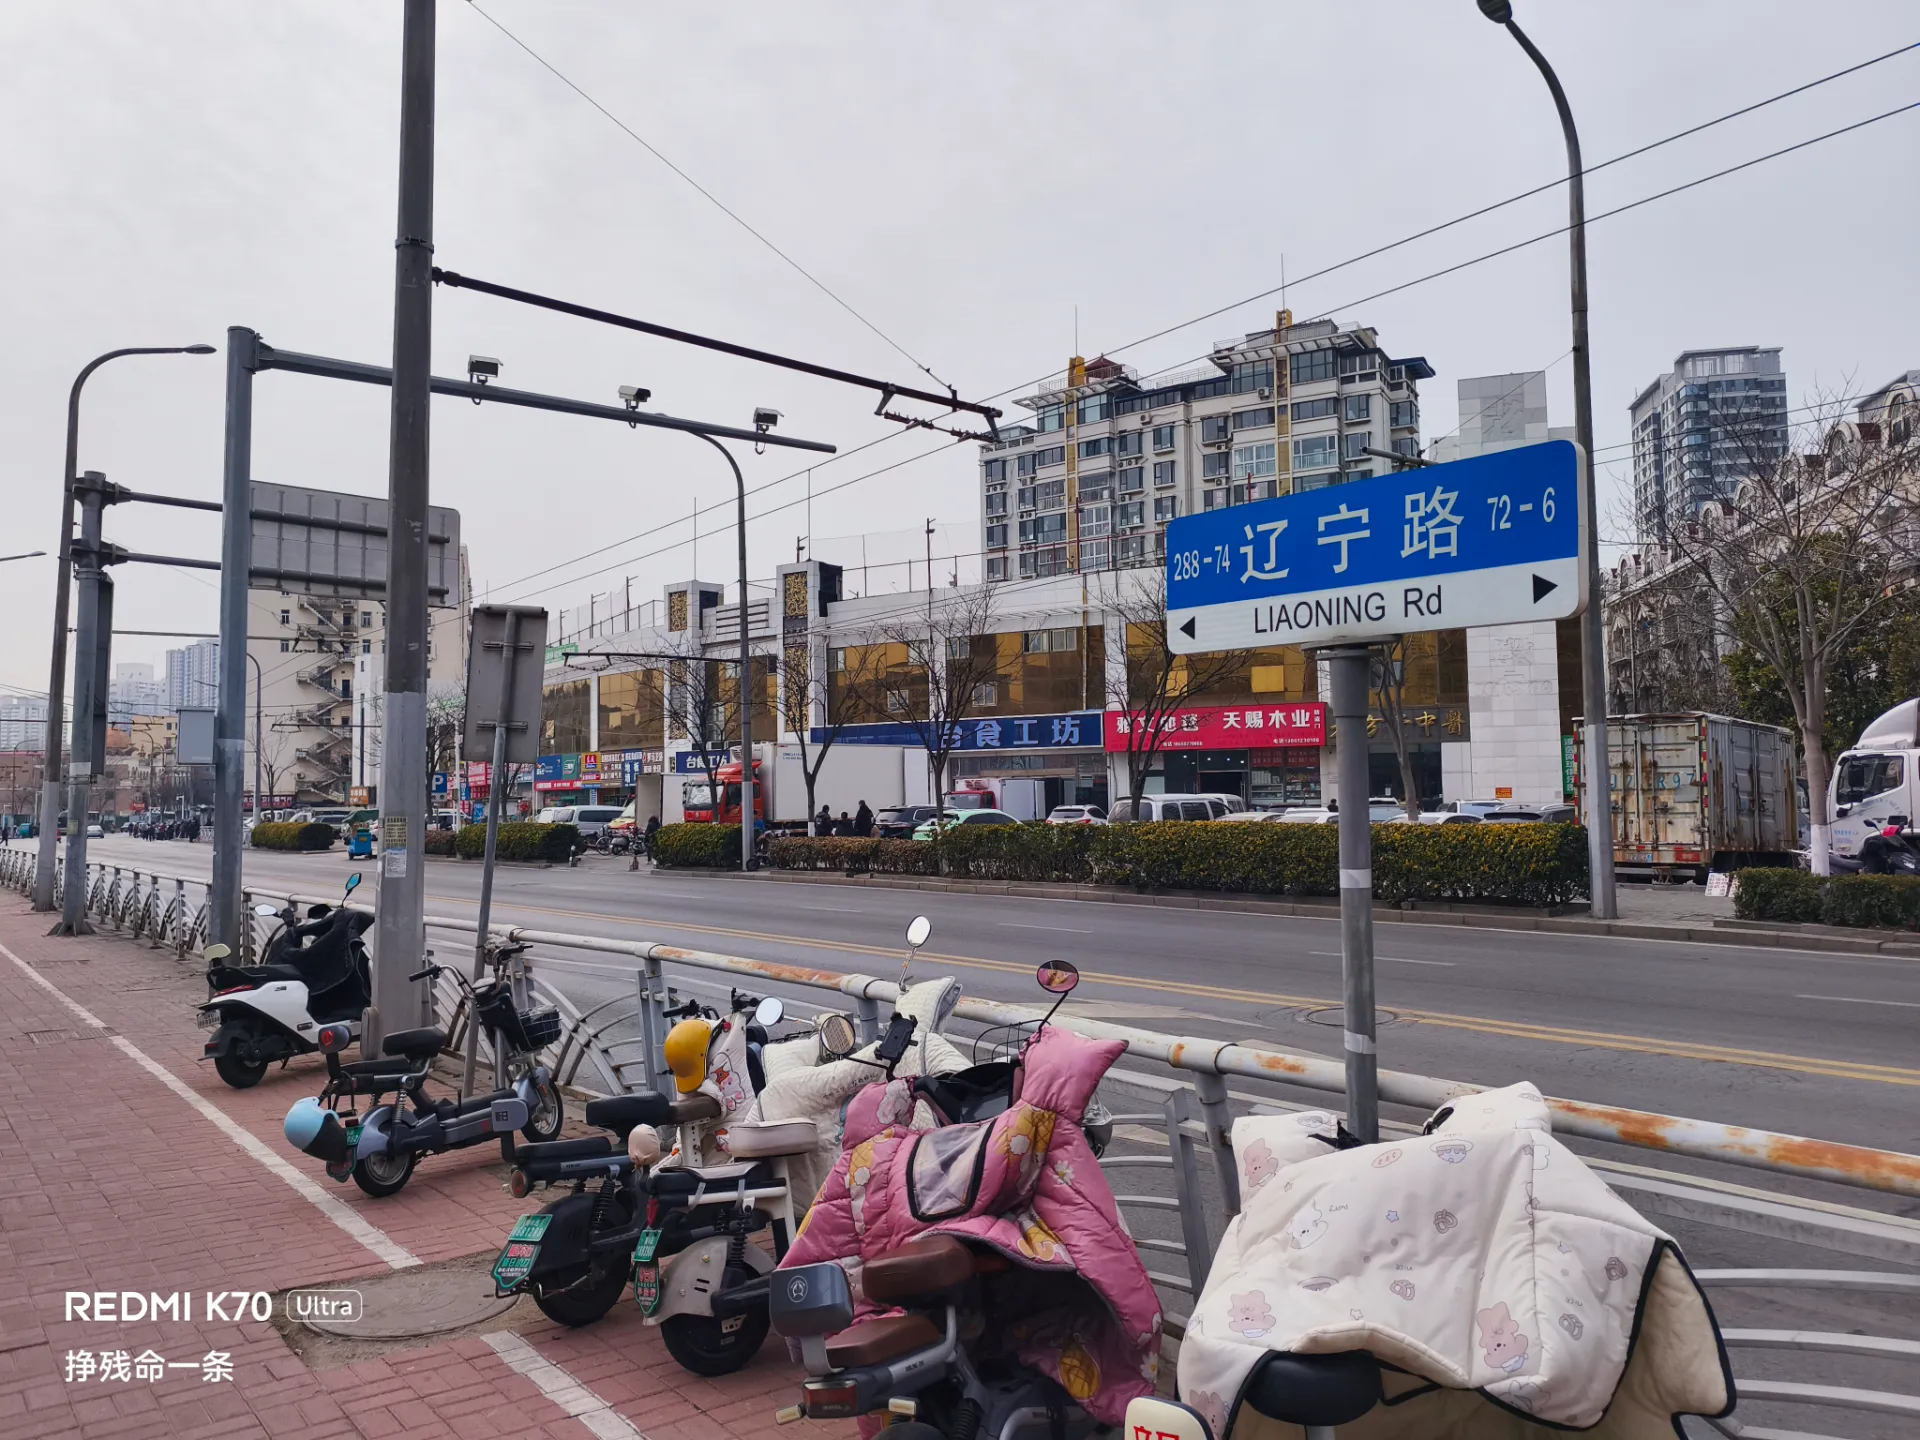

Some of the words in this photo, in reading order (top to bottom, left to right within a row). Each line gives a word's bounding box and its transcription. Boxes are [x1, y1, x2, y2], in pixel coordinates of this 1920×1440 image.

[1173, 543, 1231, 581] 288-74
[1239, 485, 1464, 584] 辽宁路
[1486, 486, 1557, 531] 72-6
[1253, 592, 1386, 634] LIAONING
[1403, 585, 1443, 618] Rd
[1222, 709, 1311, 729] 天赐木业
[432, 775, 443, 791] P
